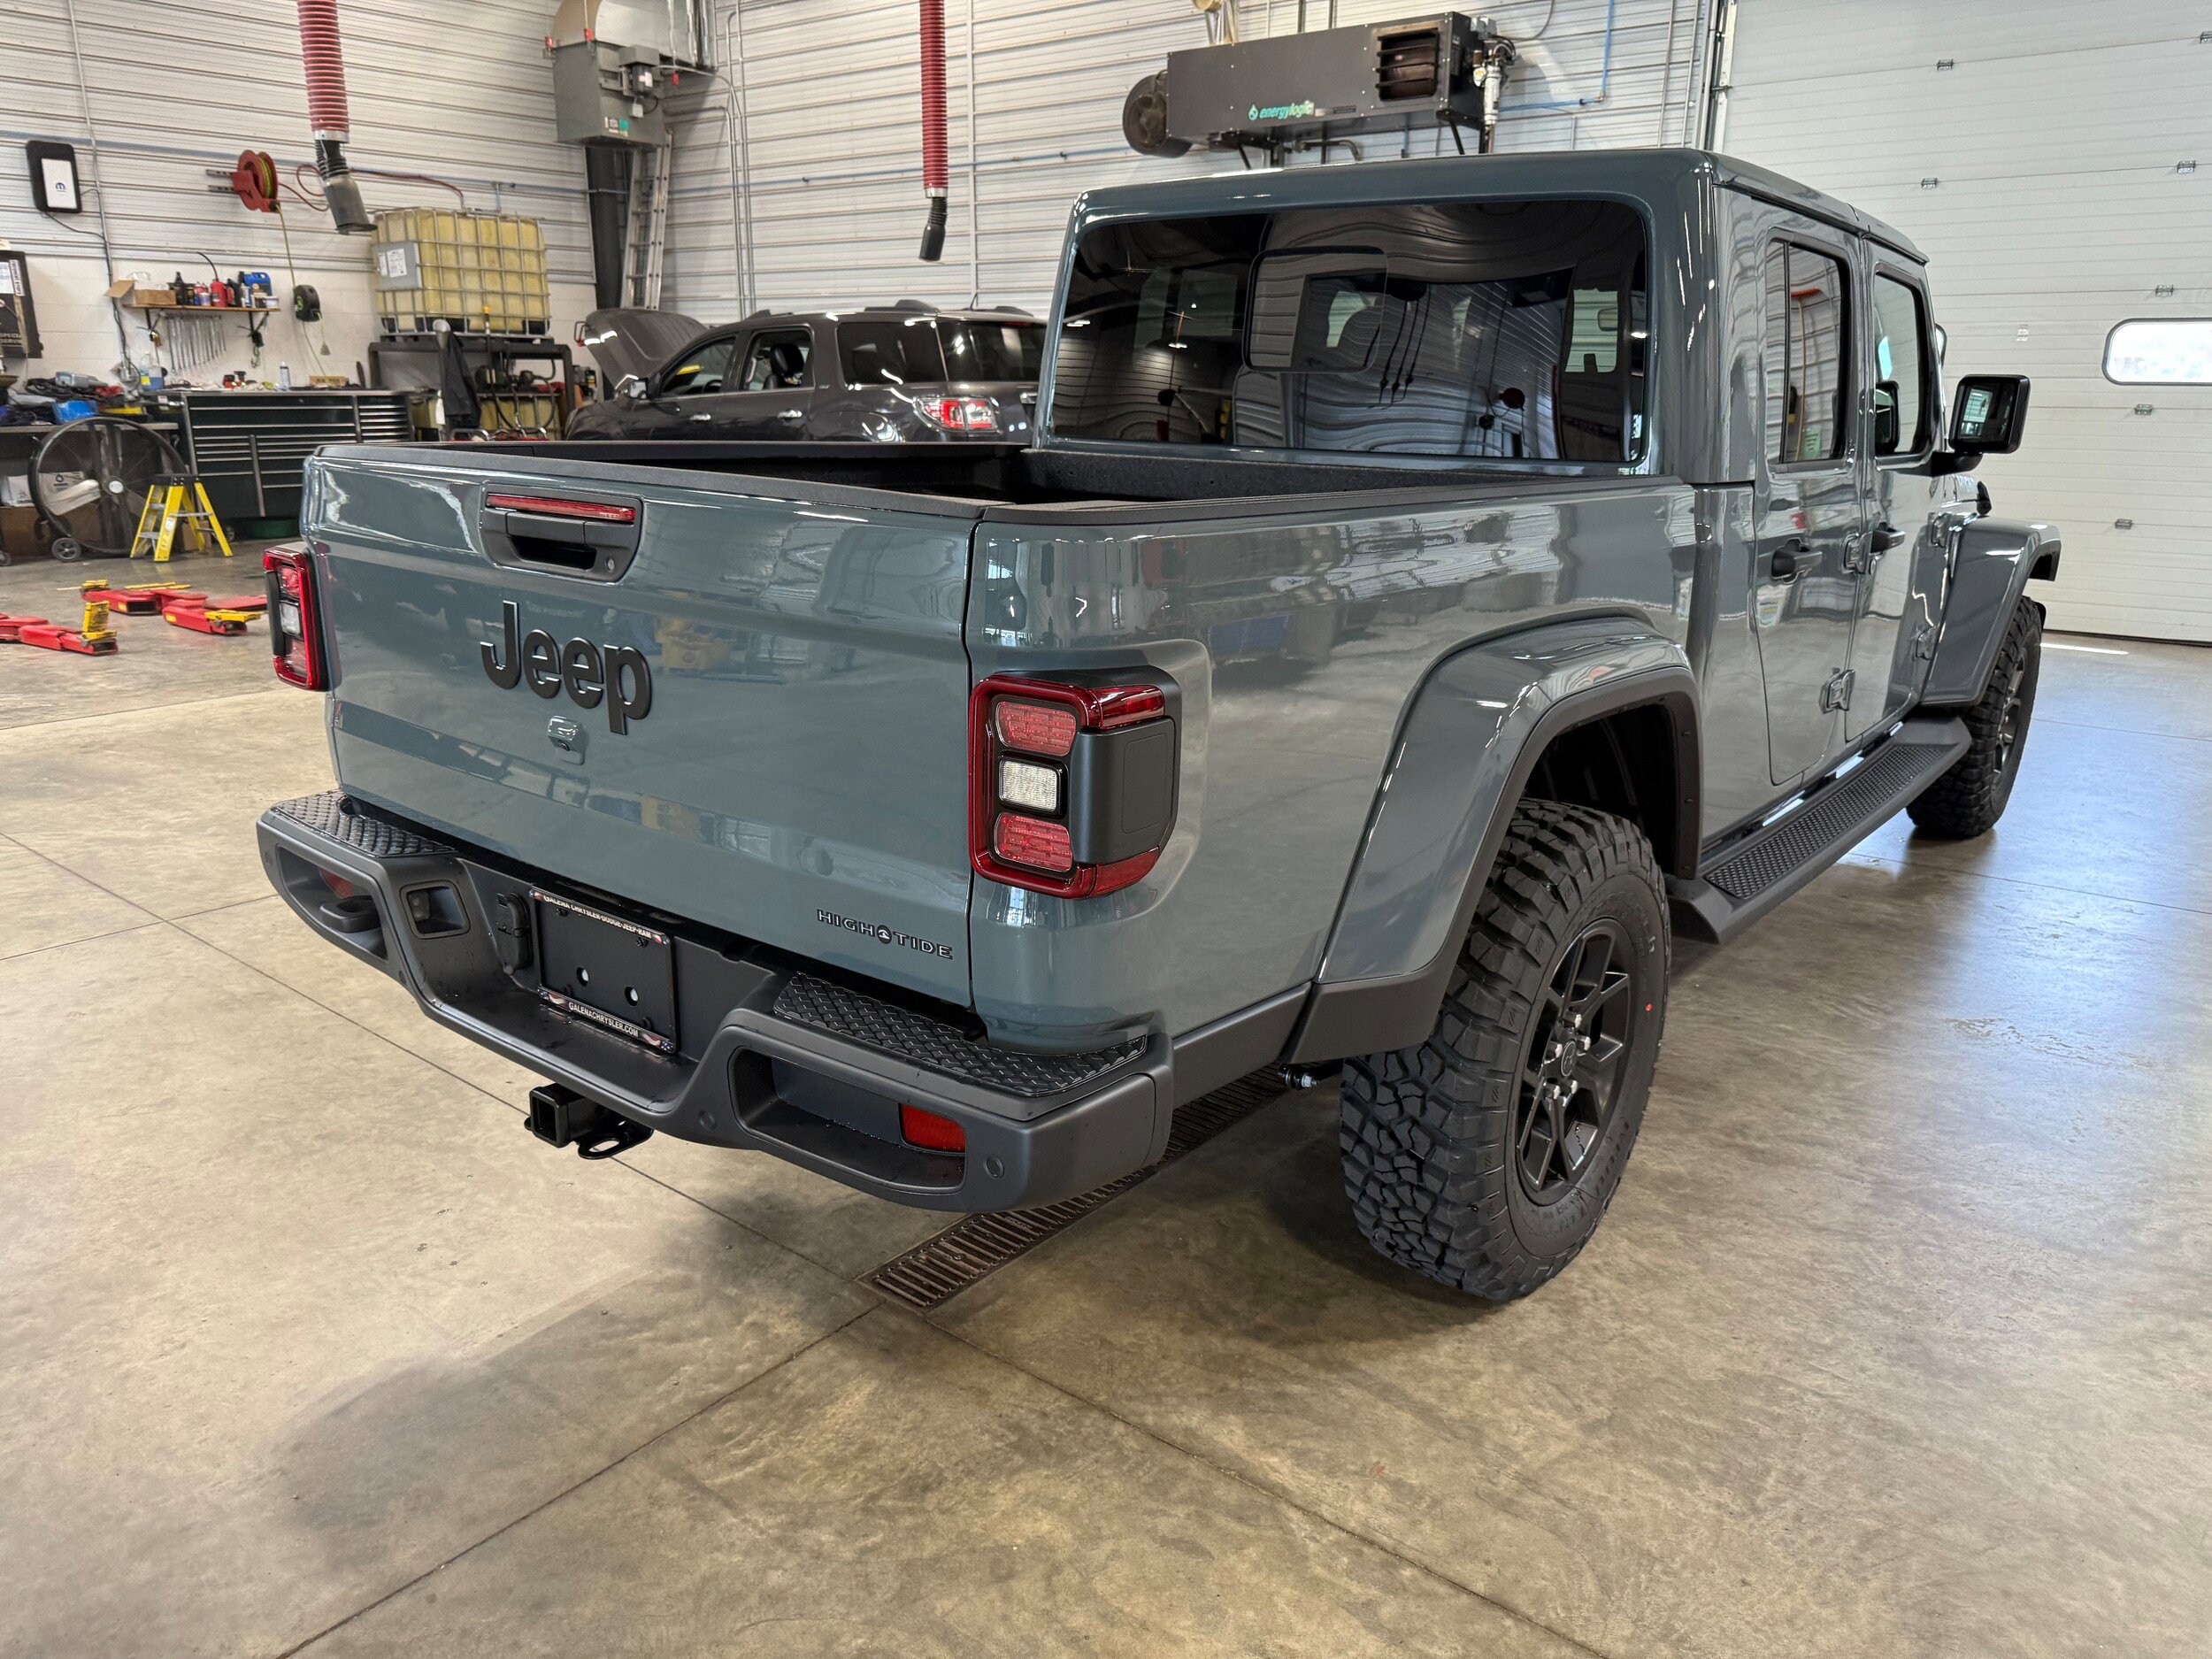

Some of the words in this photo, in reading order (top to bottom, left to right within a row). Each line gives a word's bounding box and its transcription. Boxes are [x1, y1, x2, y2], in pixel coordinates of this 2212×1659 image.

[480, 600, 652, 735] Jeep
[542, 894, 571, 910] GALENA
[817, 909, 876, 938] HIGH
[893, 931, 953, 960] TIDE
[568, 1002, 639, 1038] GALENACHRYSLER.COM
